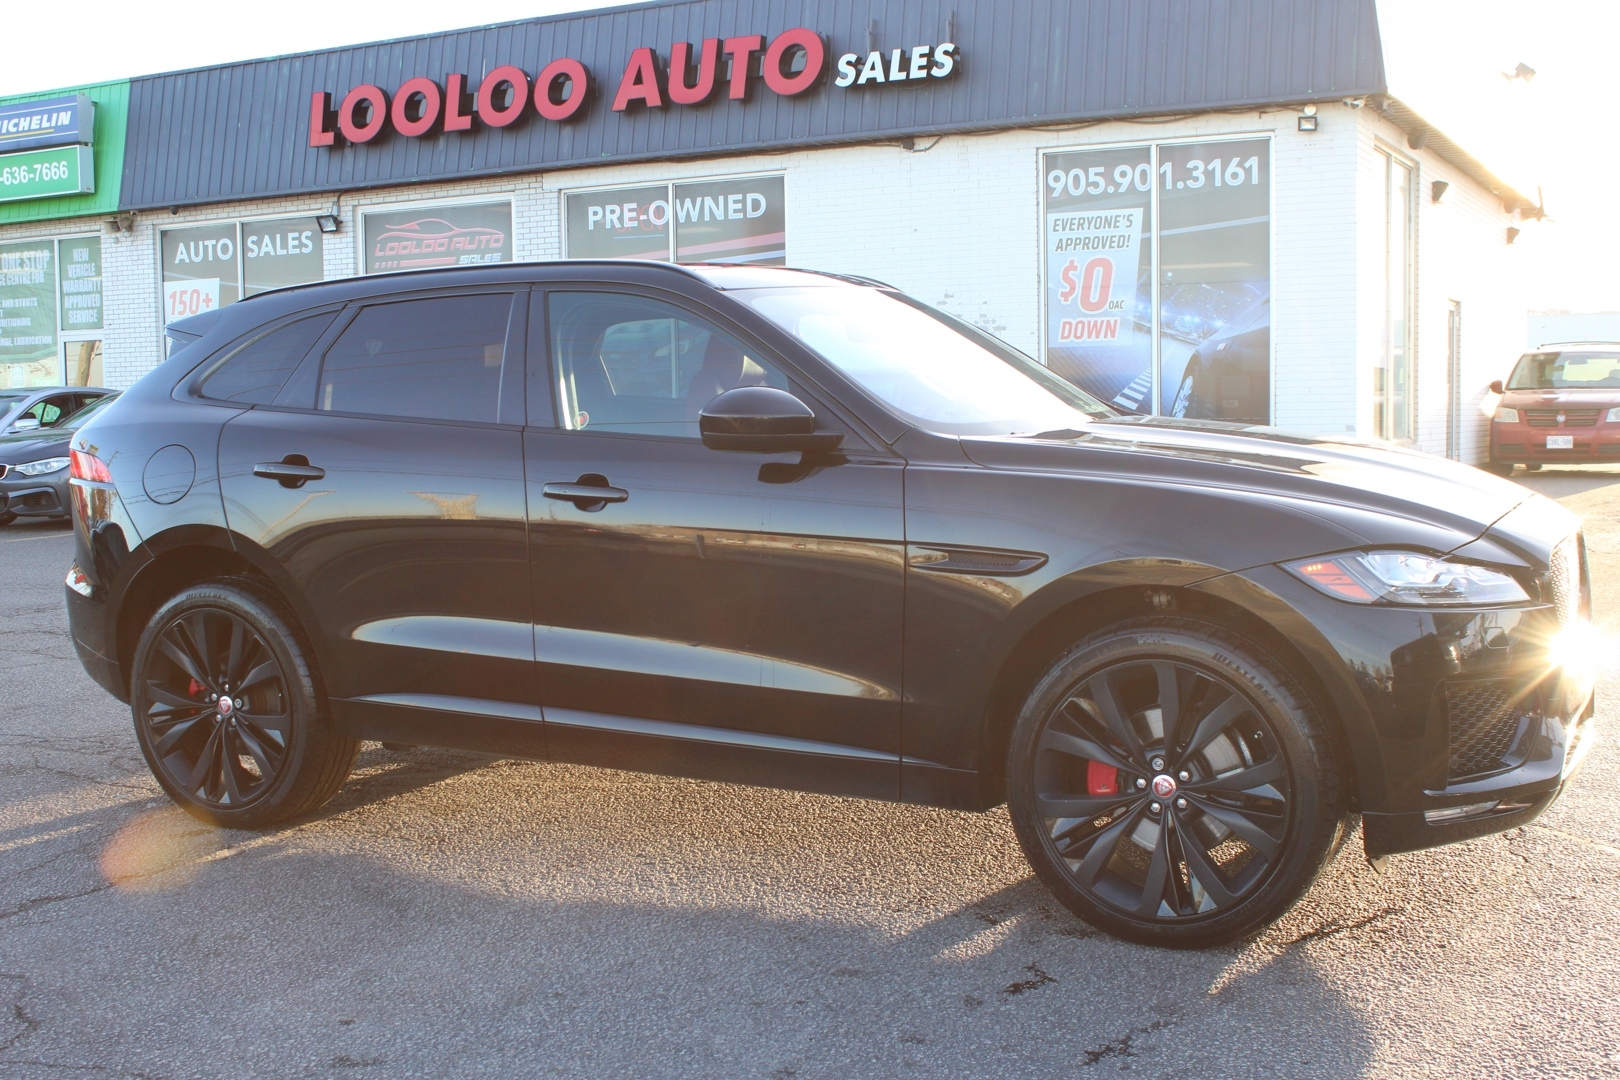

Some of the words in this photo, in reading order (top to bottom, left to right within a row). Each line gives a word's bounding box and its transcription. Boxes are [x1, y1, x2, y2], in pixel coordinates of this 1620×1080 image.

[309, 57, 588, 148] LOOLOO
[611, 28, 825, 112] AUTO
[834, 42, 956, 88] SALES
[0, 111, 72, 134] ICHELIN
[1047, 156, 1259, 198] 905.901.3161
[588, 193, 767, 231] PRE-OWNED
[1052, 214, 1134, 233] EVERYONE'S
[175, 238, 234, 264] AUTO
[247, 230, 313, 258] SALES
[374, 239, 448, 257] LOOLOO
[450, 234, 505, 251] AUTO
[1054, 234, 1131, 252] APPROVED!
[2, 252, 21, 272] ONE
[23, 249, 50, 270] STOP
[73, 248, 89, 262] NEW
[459, 252, 502, 264] SALES
[7, 272, 31, 286] CENTRE
[32, 271, 44, 284] FOR
[67, 262, 96, 278] VEHICLE
[62, 279, 102, 294] WARRANTY
[1059, 257, 1113, 312] $0
[1108, 300, 1124, 310] OAC
[2, 299, 14, 309] AND
[15, 297, 38, 308] STRUTS
[64, 293, 101, 309] APPROVED
[169, 288, 213, 316] 150+
[68, 309, 98, 324] SERVICE
[1060, 319, 1118, 341] DOWN
[14, 335, 53, 346] LUBRICATION
